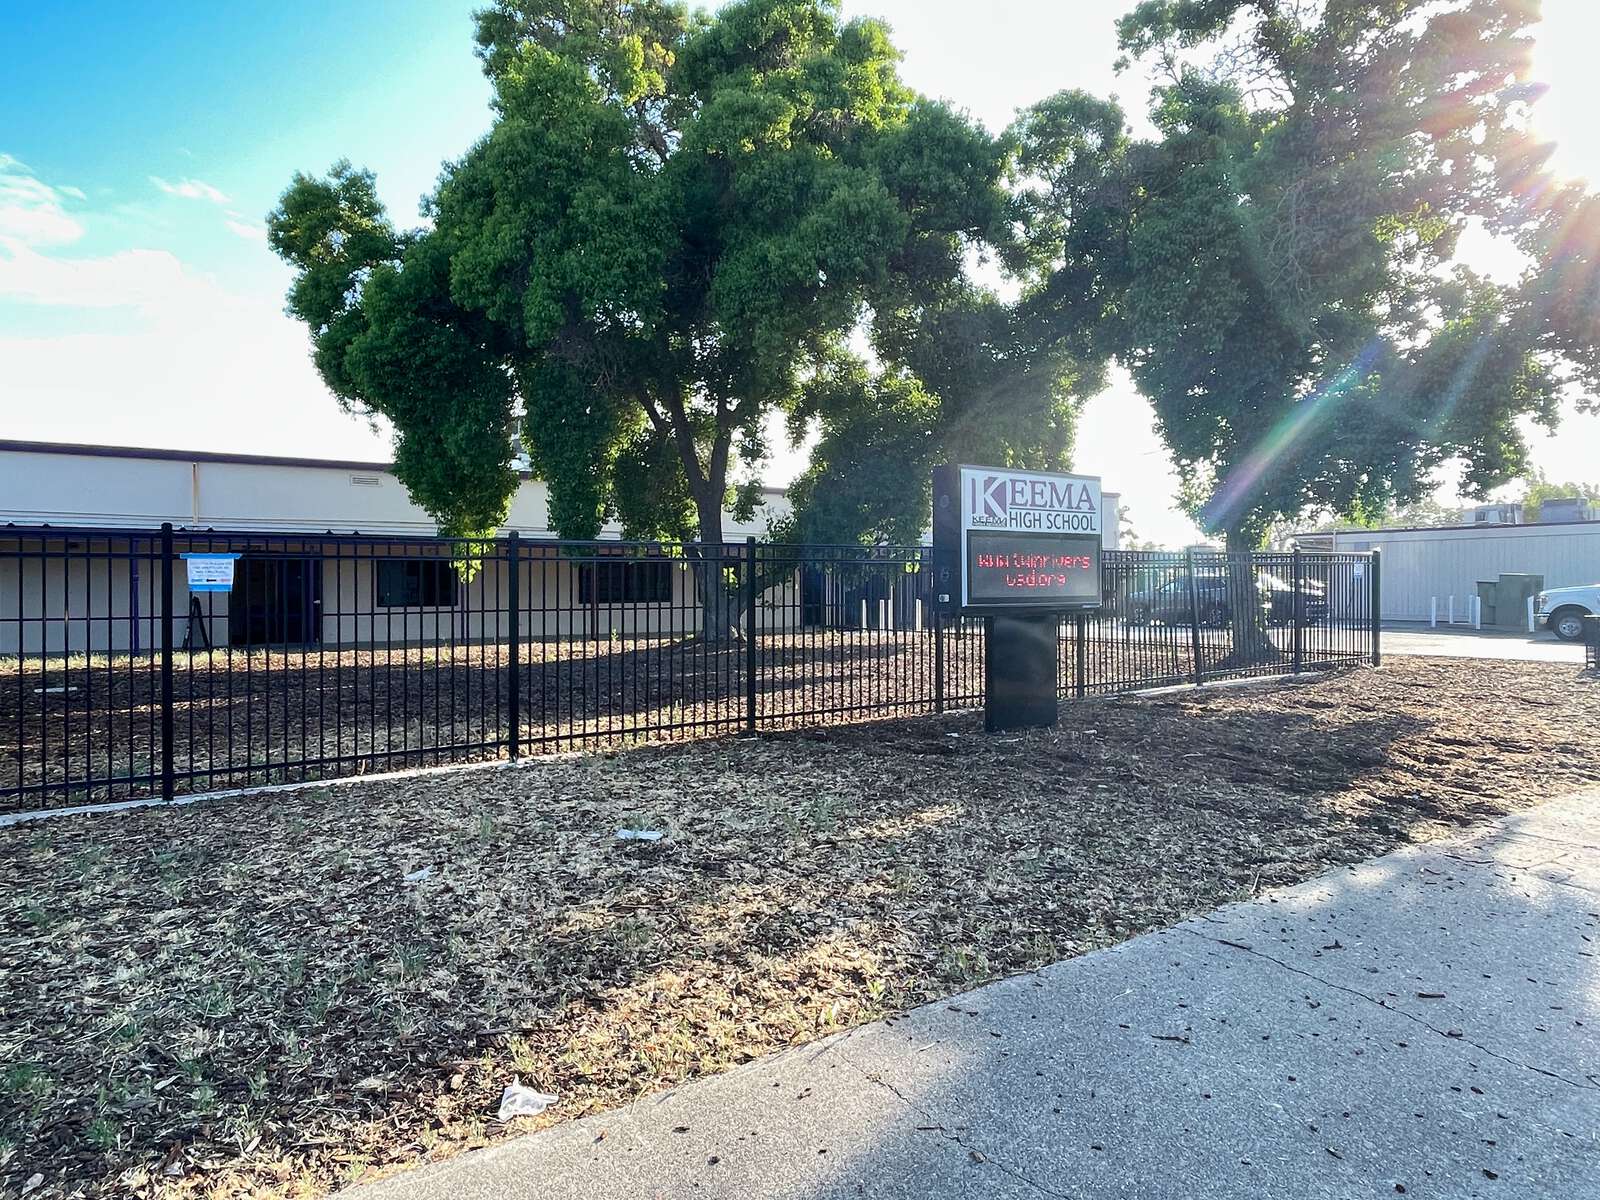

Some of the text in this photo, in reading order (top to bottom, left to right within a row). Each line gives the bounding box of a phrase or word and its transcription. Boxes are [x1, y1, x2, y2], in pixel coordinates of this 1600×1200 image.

[971, 476, 1096, 516] KEEMA
[1009, 511, 1097, 531] HIGH SCHOOL
